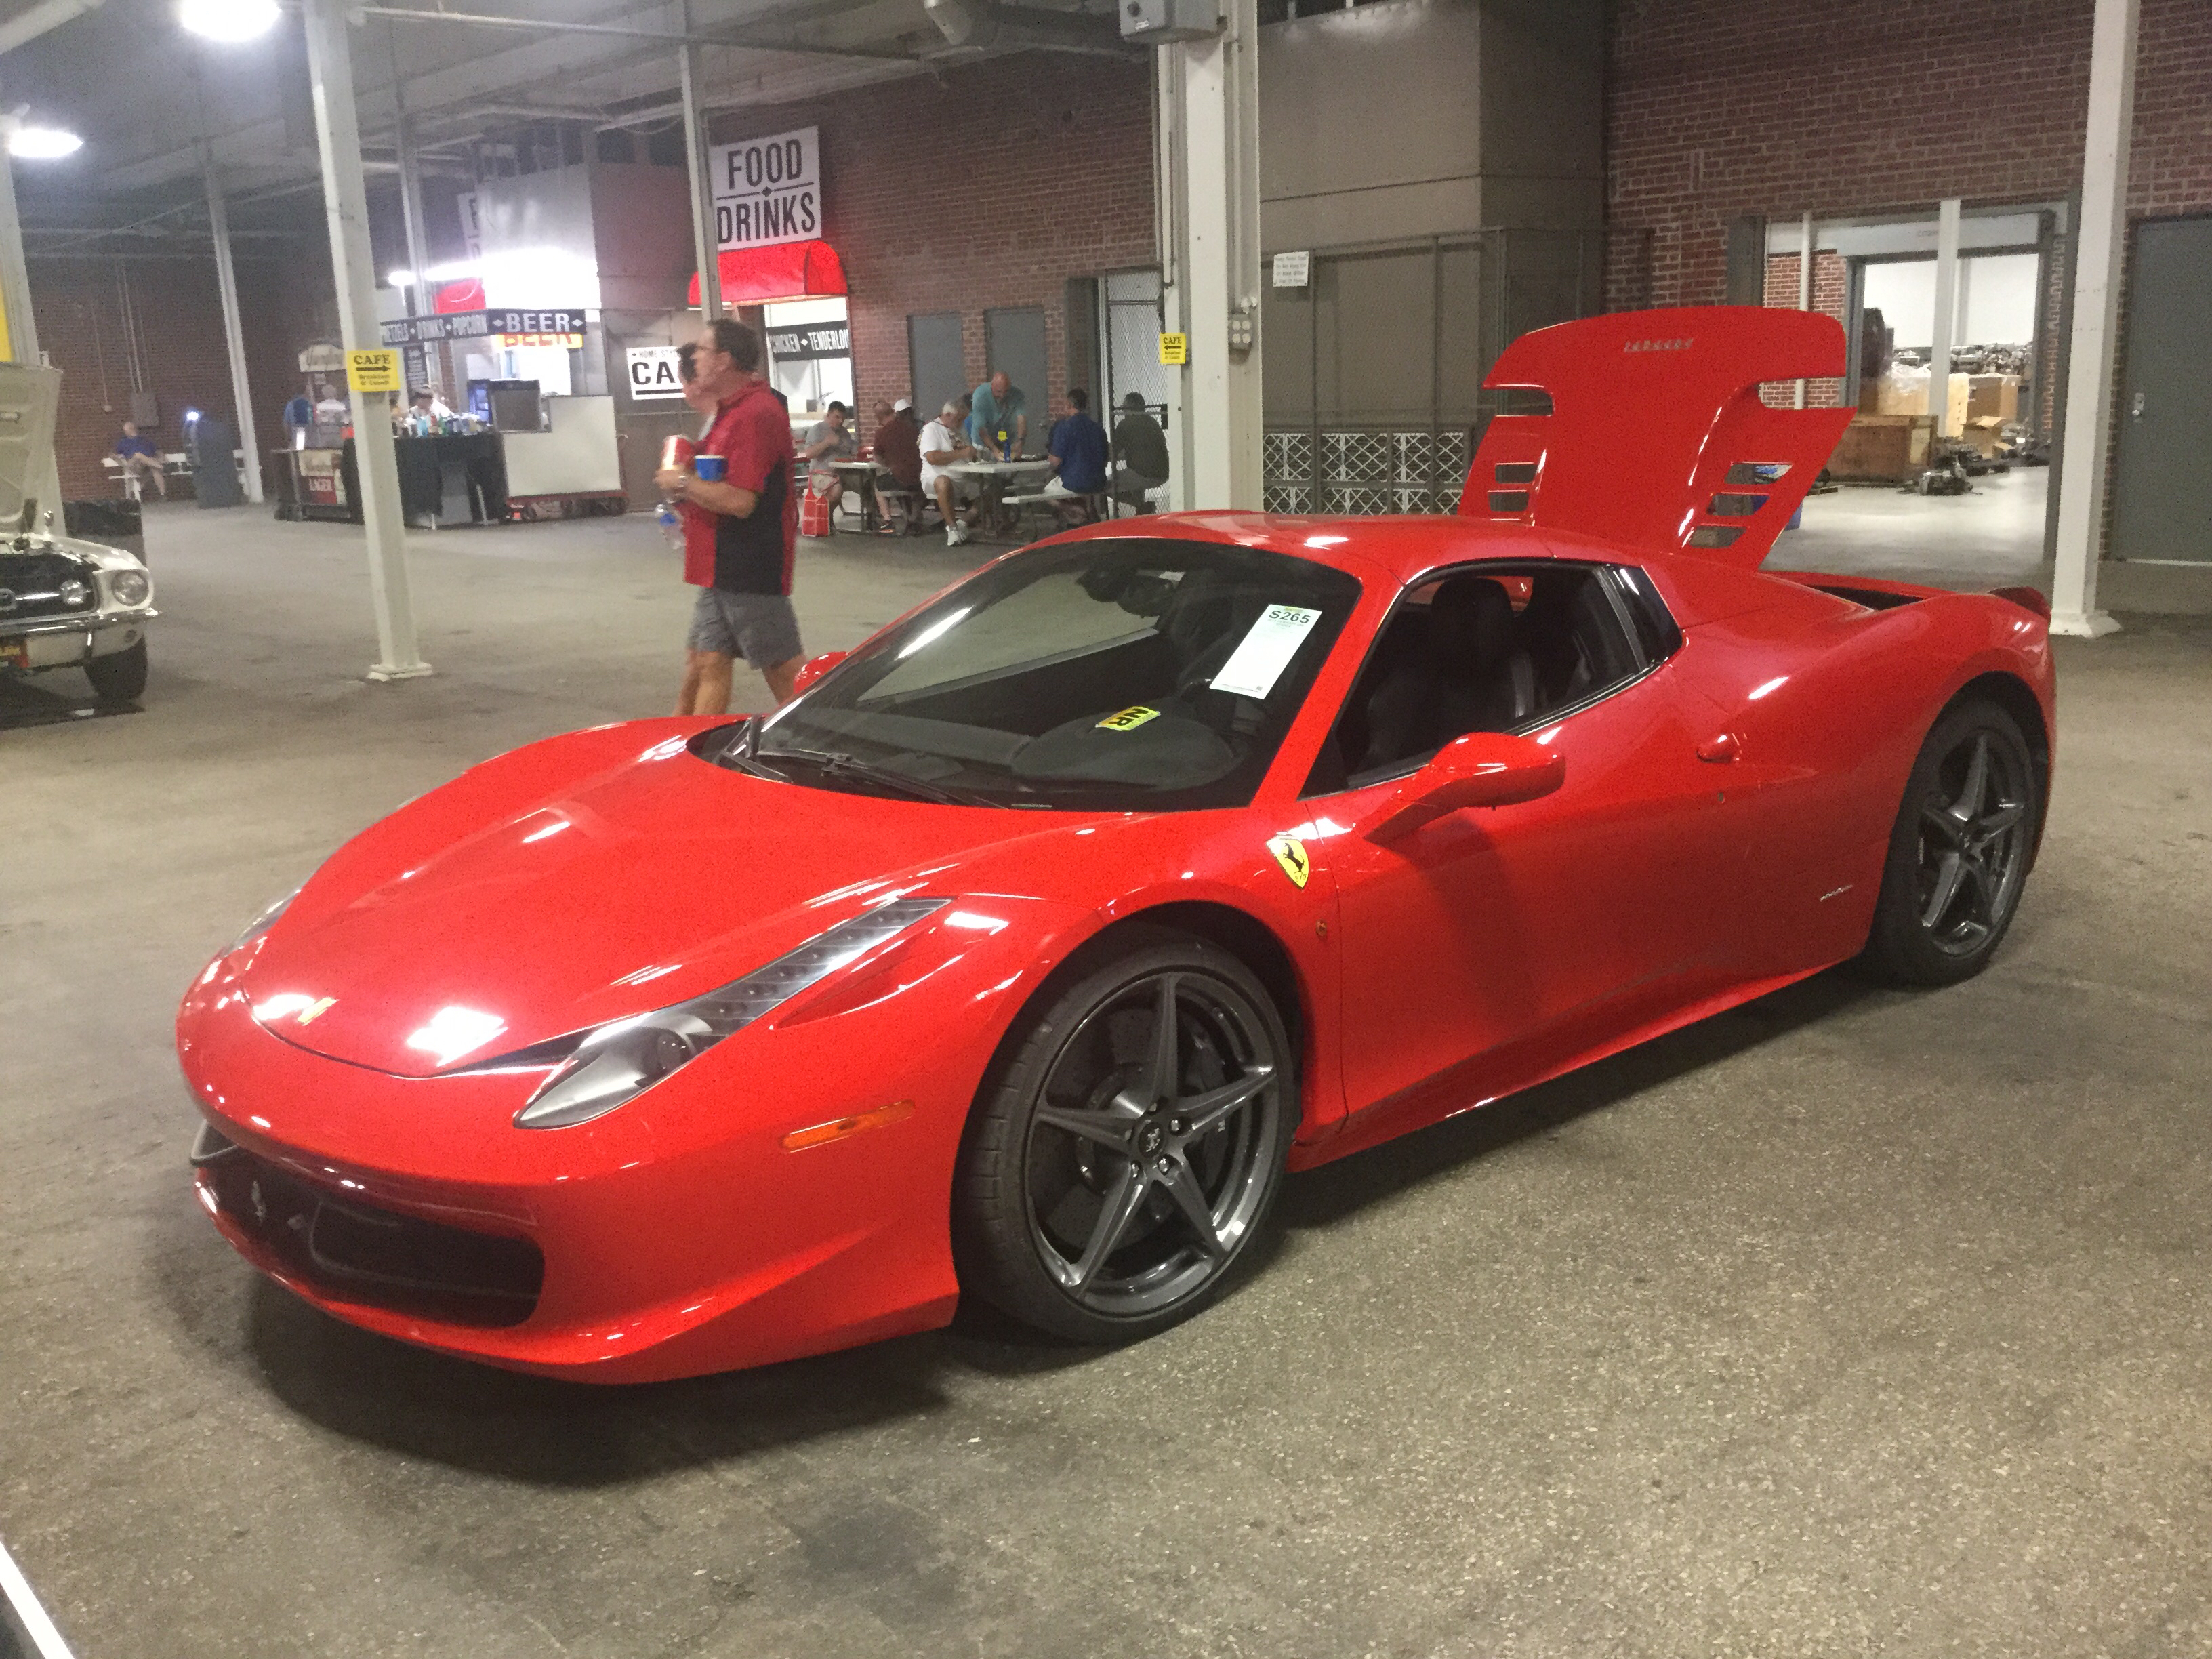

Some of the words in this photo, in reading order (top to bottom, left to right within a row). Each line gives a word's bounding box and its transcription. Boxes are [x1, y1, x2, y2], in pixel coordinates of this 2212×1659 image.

[727, 138, 802, 190] FOOD
[717, 192, 815, 244] DRINKS
[452, 314, 488, 336] POPCORN
[506, 312, 570, 333] BEER
[769, 333, 801, 354] CHICKEN
[1163, 336, 1182, 344] CAFE
[354, 354, 391, 365] CAFE
[632, 361, 676, 385] CA
[1269, 610, 1311, 624] S265
[1108, 708, 1150, 726] NR
